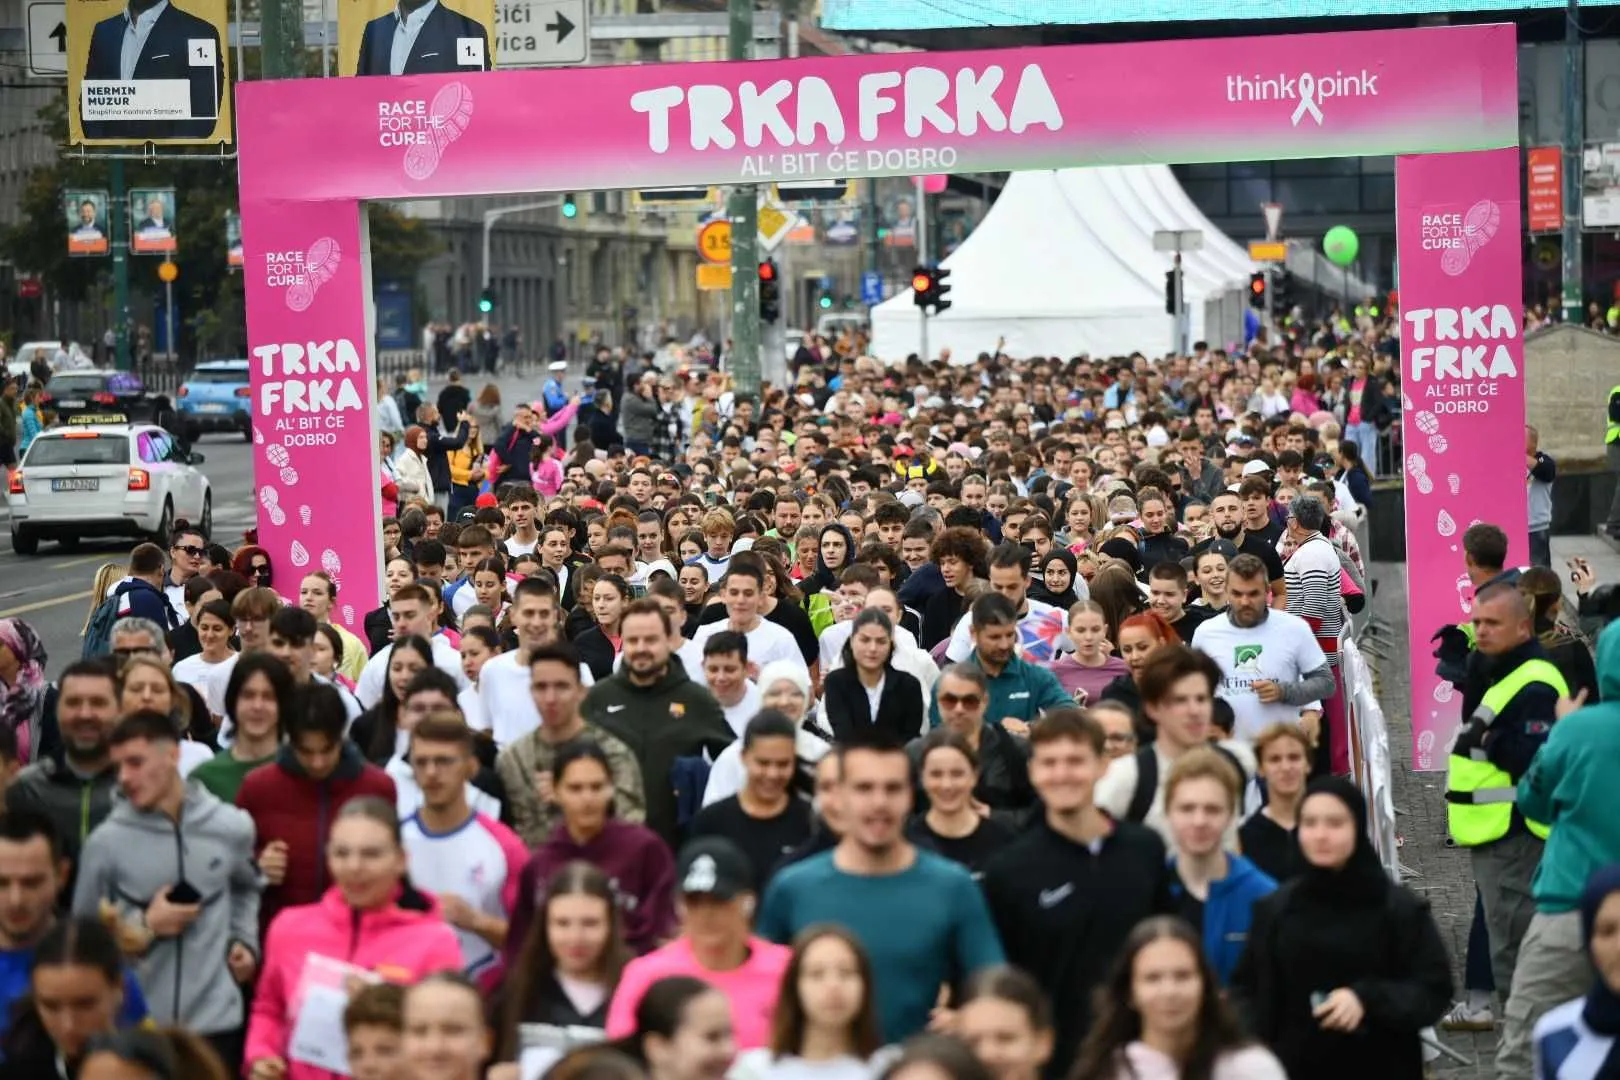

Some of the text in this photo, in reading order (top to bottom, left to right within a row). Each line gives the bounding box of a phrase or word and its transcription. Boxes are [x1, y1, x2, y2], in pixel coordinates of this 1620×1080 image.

[196, 46, 208, 59] 1.
[465, 45, 476, 57] 1.
[87, 86, 136, 96] NERMIN
[1226, 69, 1379, 105] think pink
[88, 97, 130, 106] MUZUR
[379, 100, 427, 116] RACE
[630, 63, 1064, 154] TRKA FRKA
[380, 114, 446, 131] FOR THE
[741, 146, 958, 176] AL' BIT ĆE DOBRO
[1422, 214, 1462, 226] RACE
[1422, 224, 1477, 238] FOR THE
[266, 251, 304, 263] RACE
[267, 261, 319, 275] FOR THE
[1404, 304, 1517, 342] TRKA
[253, 338, 361, 376] TRKA
[1411, 344, 1517, 382] FRKA
[1425, 379, 1499, 397] AL' BIT ĆE
[261, 377, 363, 416] FRKA
[1434, 400, 1489, 414] DOBRO
[275, 413, 345, 431] AL' BIT ĆE
[284, 433, 337, 447] DOBRO
